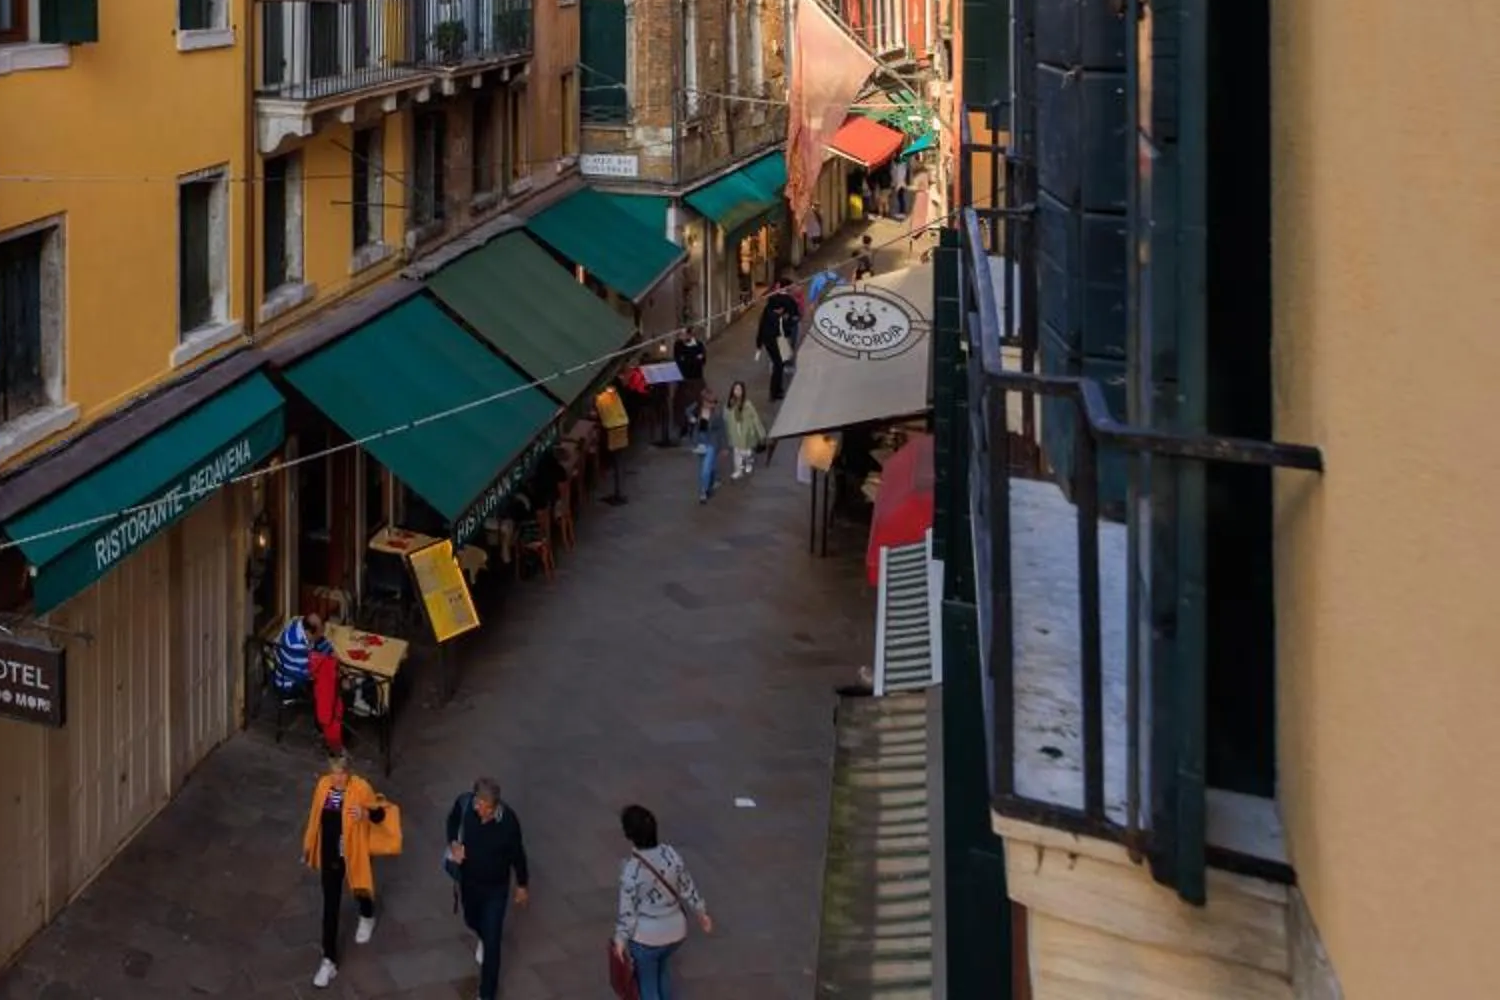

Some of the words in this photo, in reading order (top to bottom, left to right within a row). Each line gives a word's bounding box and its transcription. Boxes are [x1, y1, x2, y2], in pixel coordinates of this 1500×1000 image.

[820, 318, 903, 347] CONCORDIA
[95, 484, 184, 570] RISTORANTE
[189, 439, 251, 500] PEDAVENA
